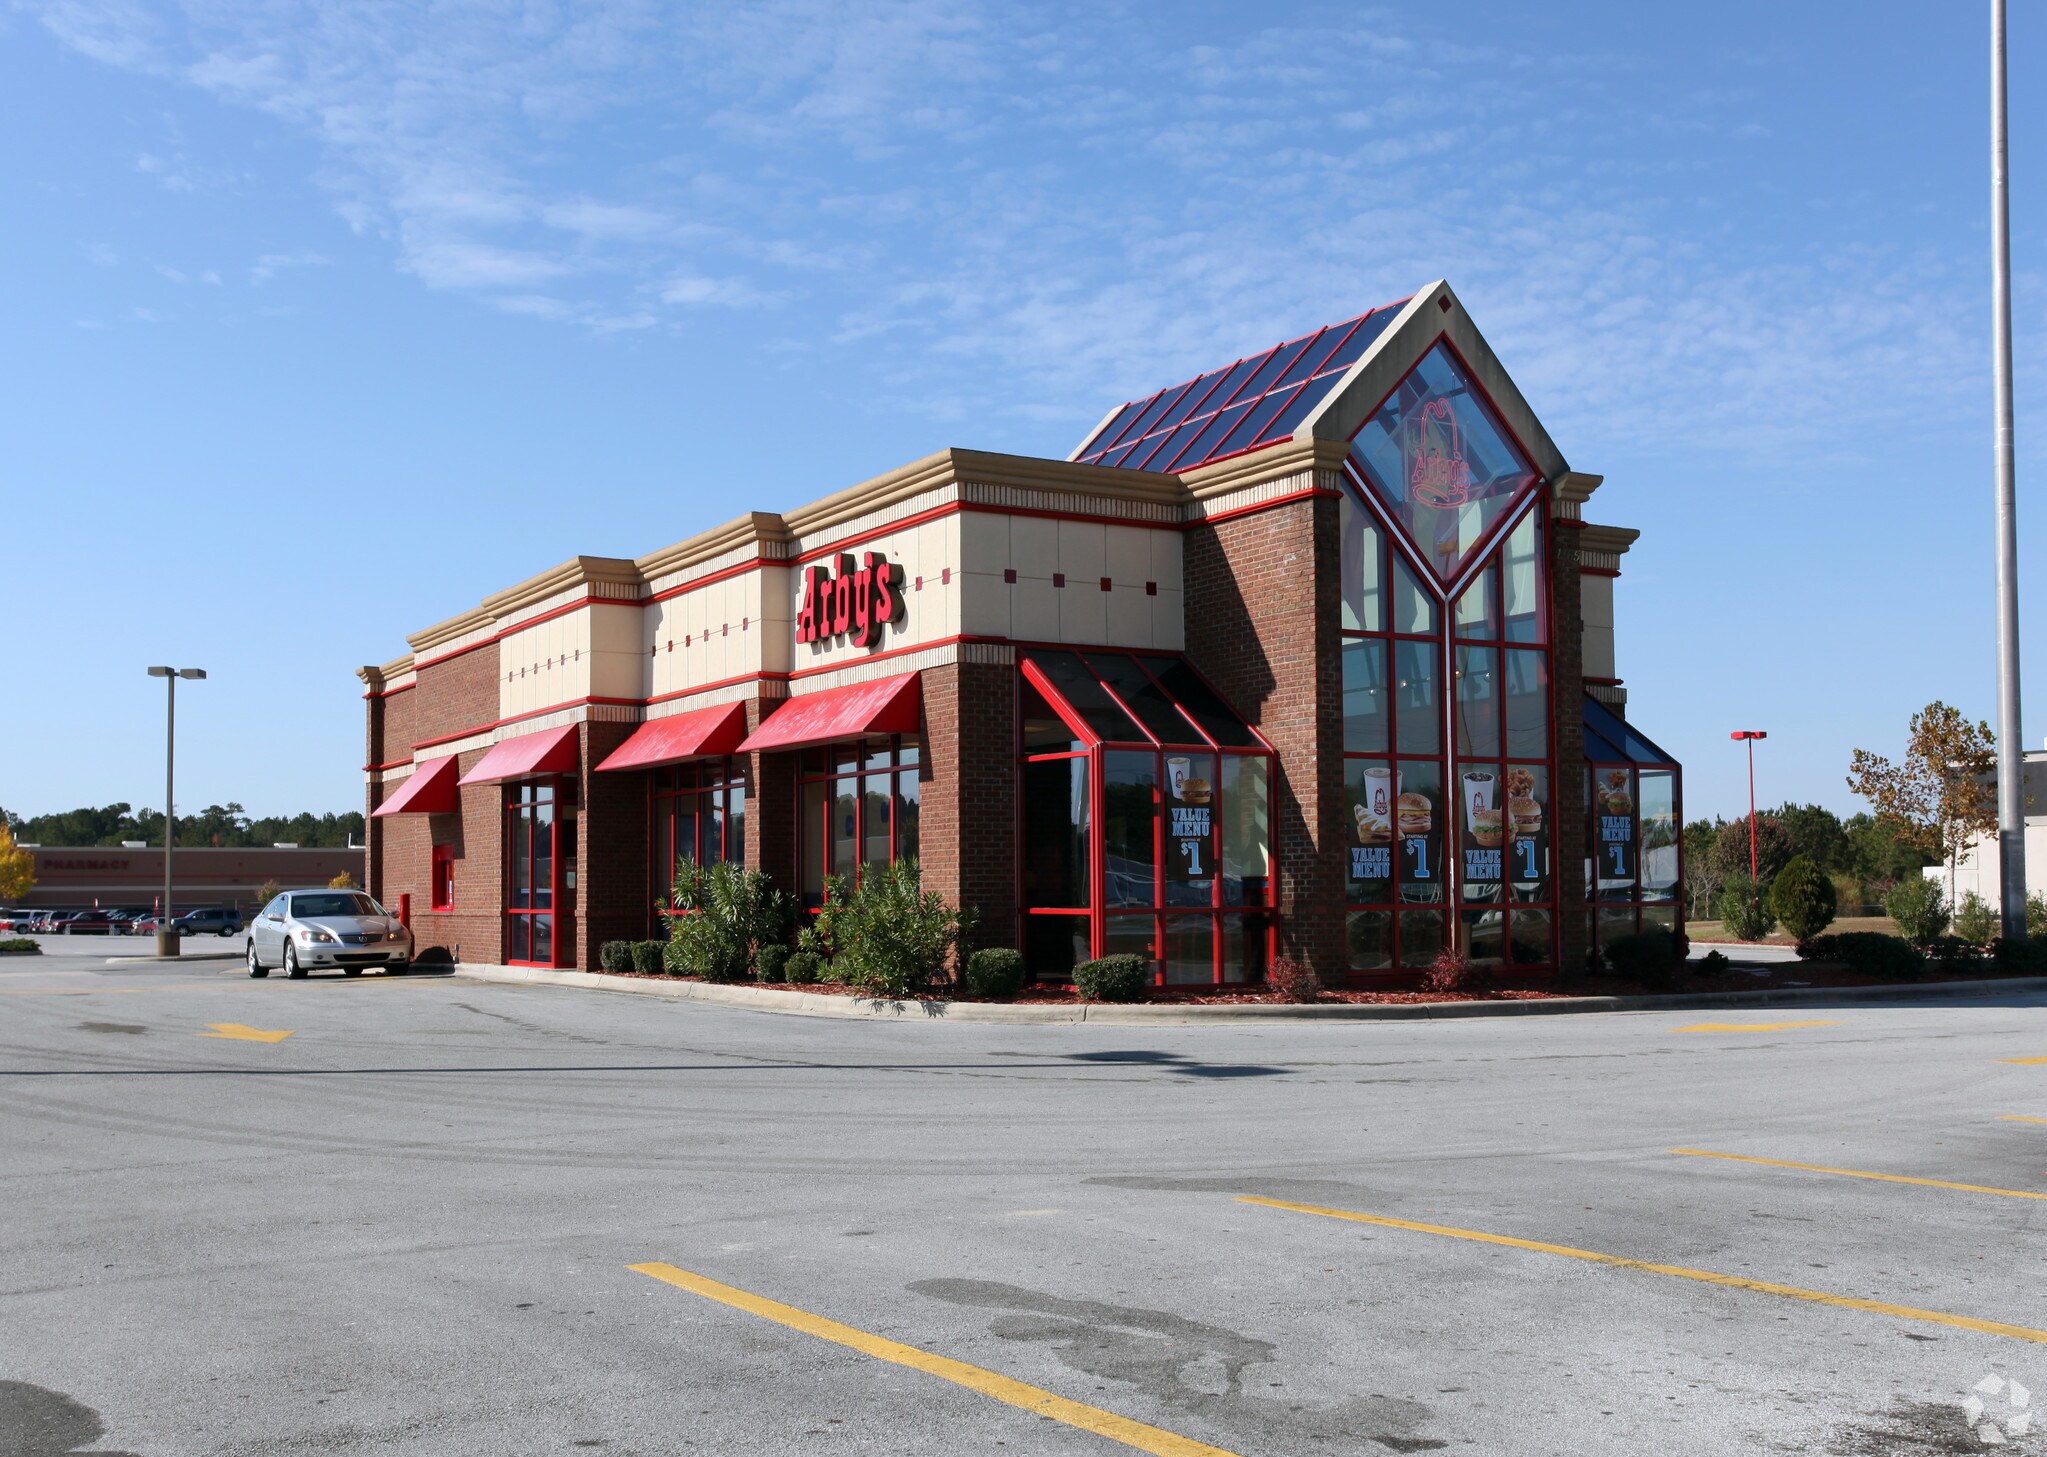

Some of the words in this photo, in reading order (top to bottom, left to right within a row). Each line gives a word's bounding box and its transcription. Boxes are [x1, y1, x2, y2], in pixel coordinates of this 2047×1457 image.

[1411, 447, 1471, 495] Arby's
[796, 551, 896, 648] Arby's
[1171, 807, 1210, 821] VALUE
[1601, 815, 1631, 828] VALUE
[1172, 821, 1210, 837] MENU
[1602, 828, 1631, 842] MENU
[1181, 841, 1203, 875] $1
[1351, 847, 1390, 862] VALUE
[1406, 839, 1430, 878] $1
[1465, 849, 1501, 863] VALUE
[1516, 840, 1539, 878] $1
[1609, 846, 1626, 875] $1
[43, 859, 130, 870] PHARMACY
[1352, 862, 1390, 878] MENU
[1466, 863, 1501, 879] MENU
